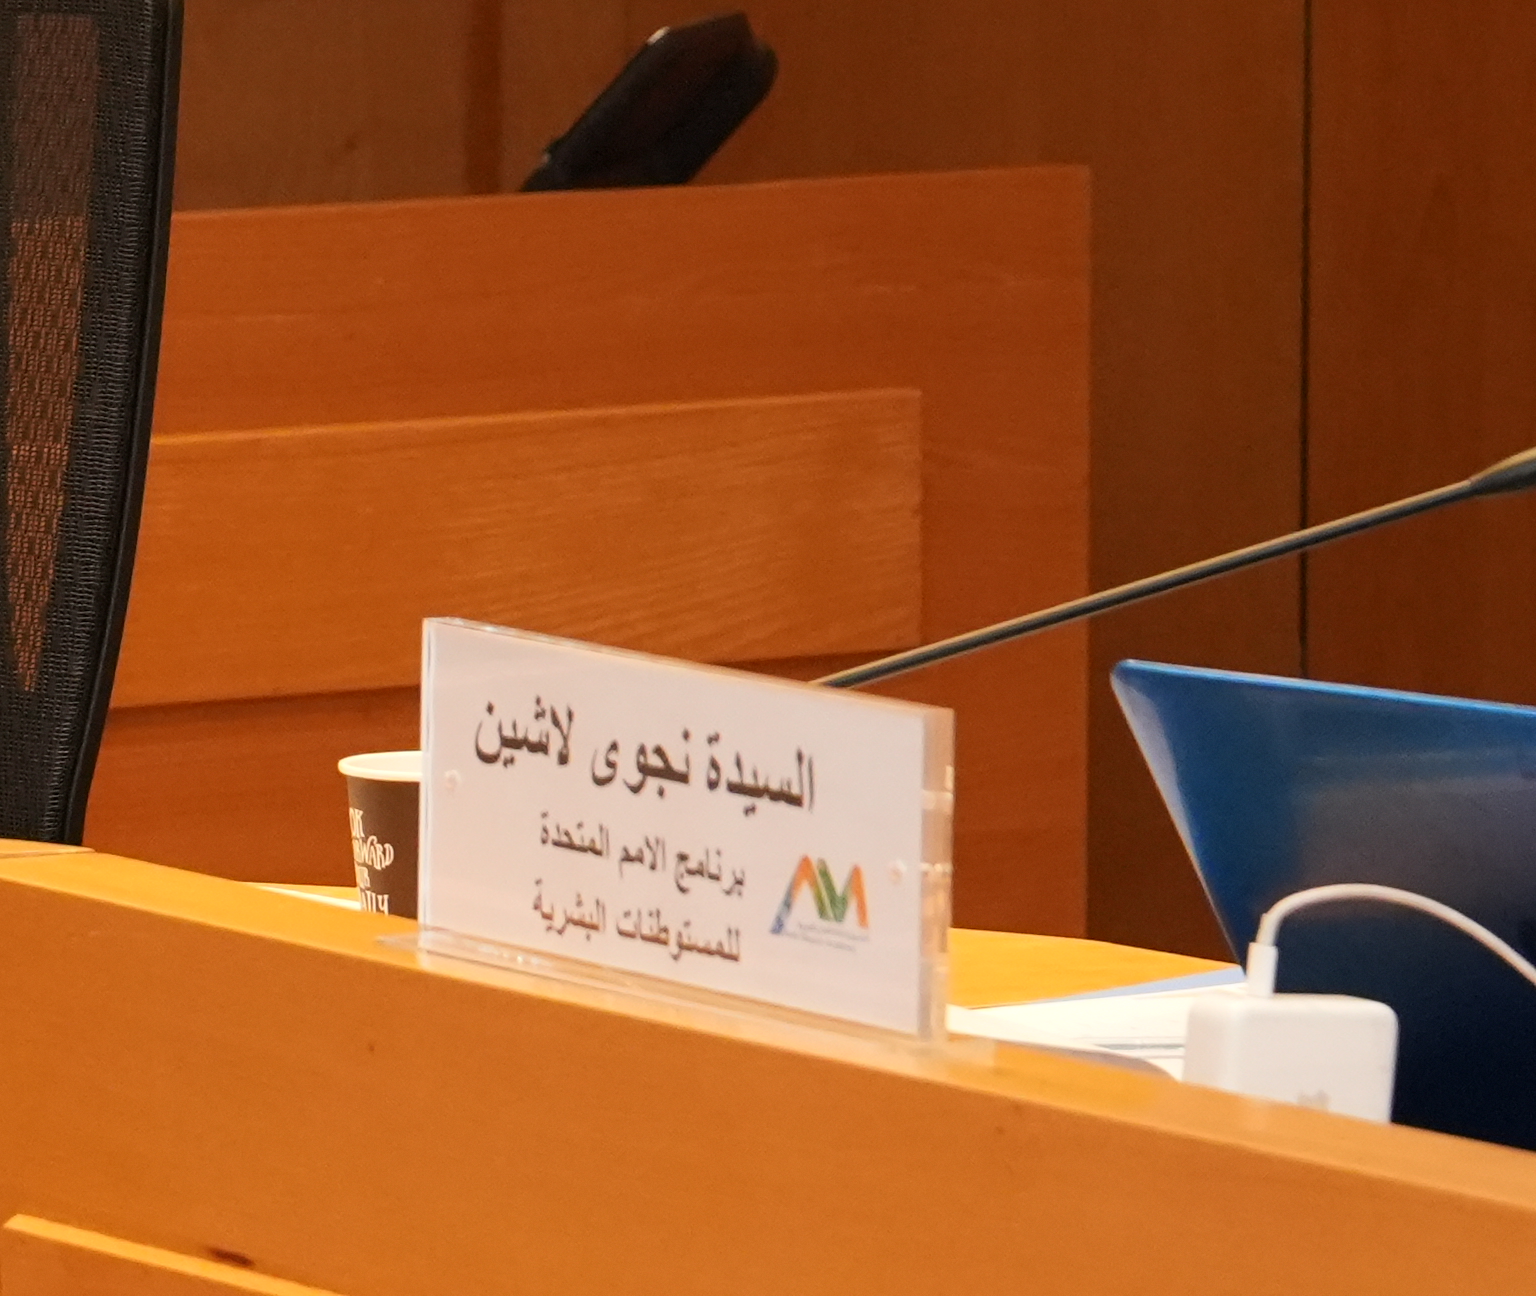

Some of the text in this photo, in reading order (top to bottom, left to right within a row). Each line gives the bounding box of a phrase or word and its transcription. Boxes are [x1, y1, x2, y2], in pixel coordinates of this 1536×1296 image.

[474, 695, 814, 817] السيدة نجوى لاشين
[540, 812, 745, 896] برنامج الامم المتحدة
[533, 879, 740, 963] للمستوطنات البشرية
